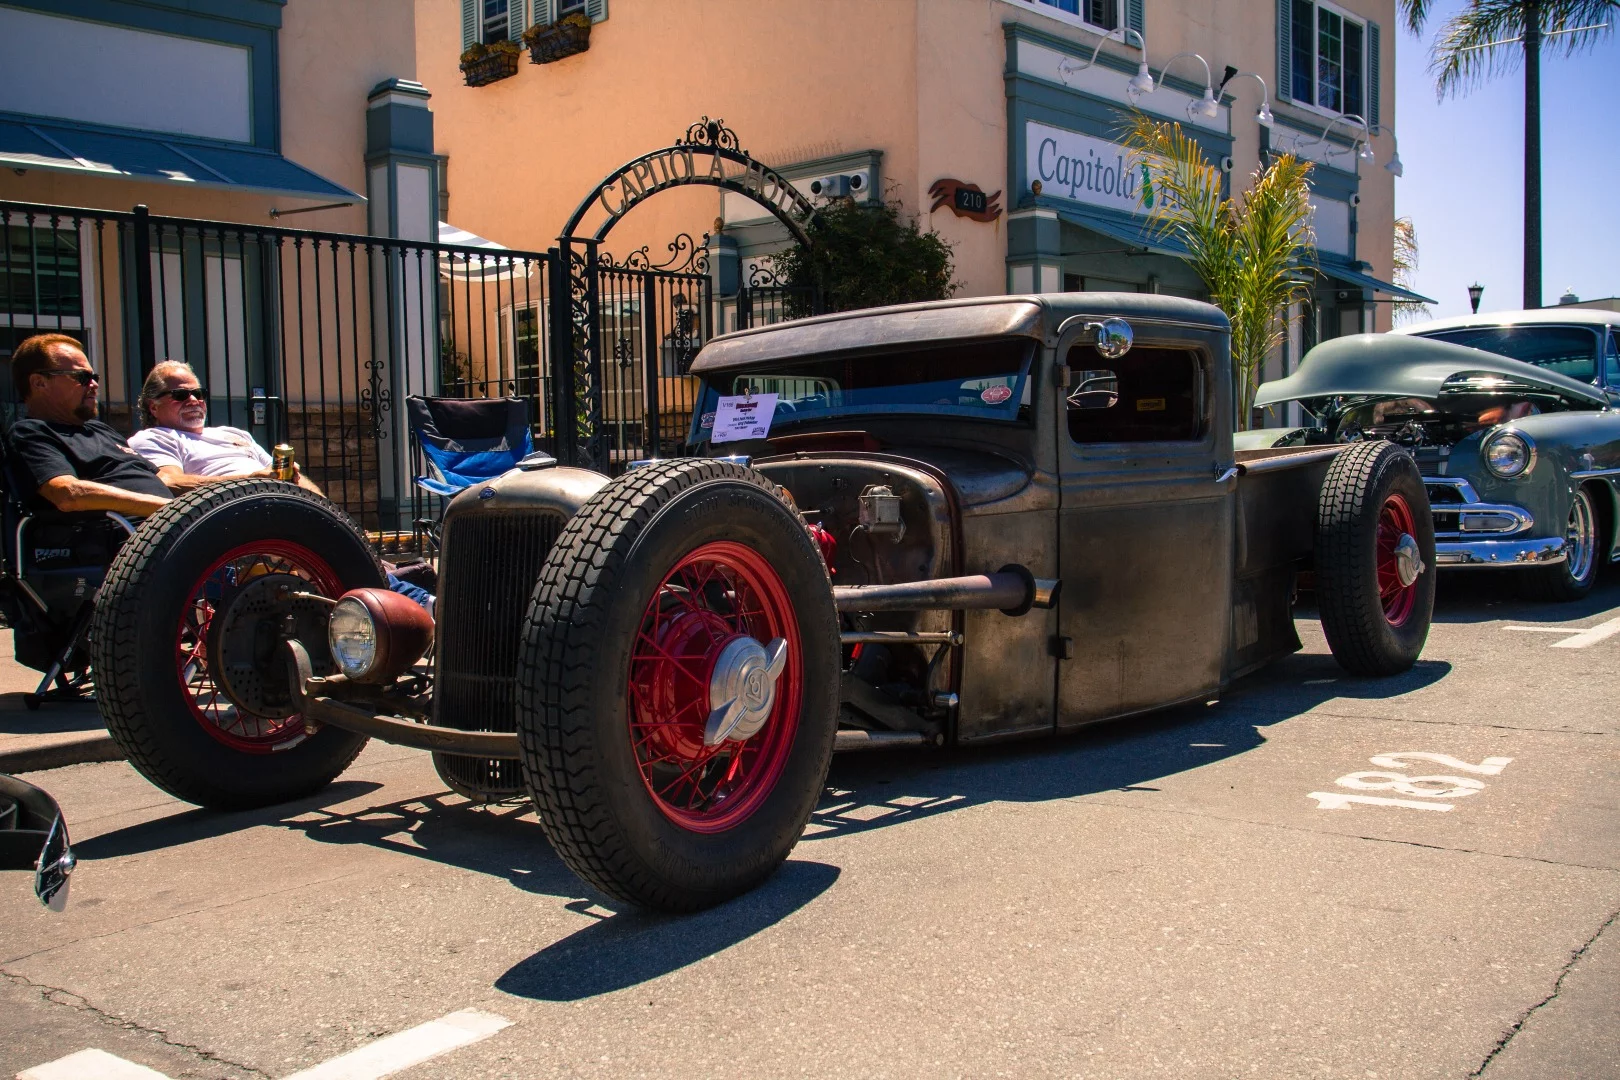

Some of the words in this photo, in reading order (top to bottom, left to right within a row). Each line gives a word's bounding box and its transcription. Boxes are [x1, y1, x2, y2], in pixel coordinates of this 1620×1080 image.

[600, 149, 728, 218] CAPITOLA
[1038, 137, 1136, 200] Capitola
[963, 192, 982, 209] 210
[1306, 751, 1515, 812] 182
